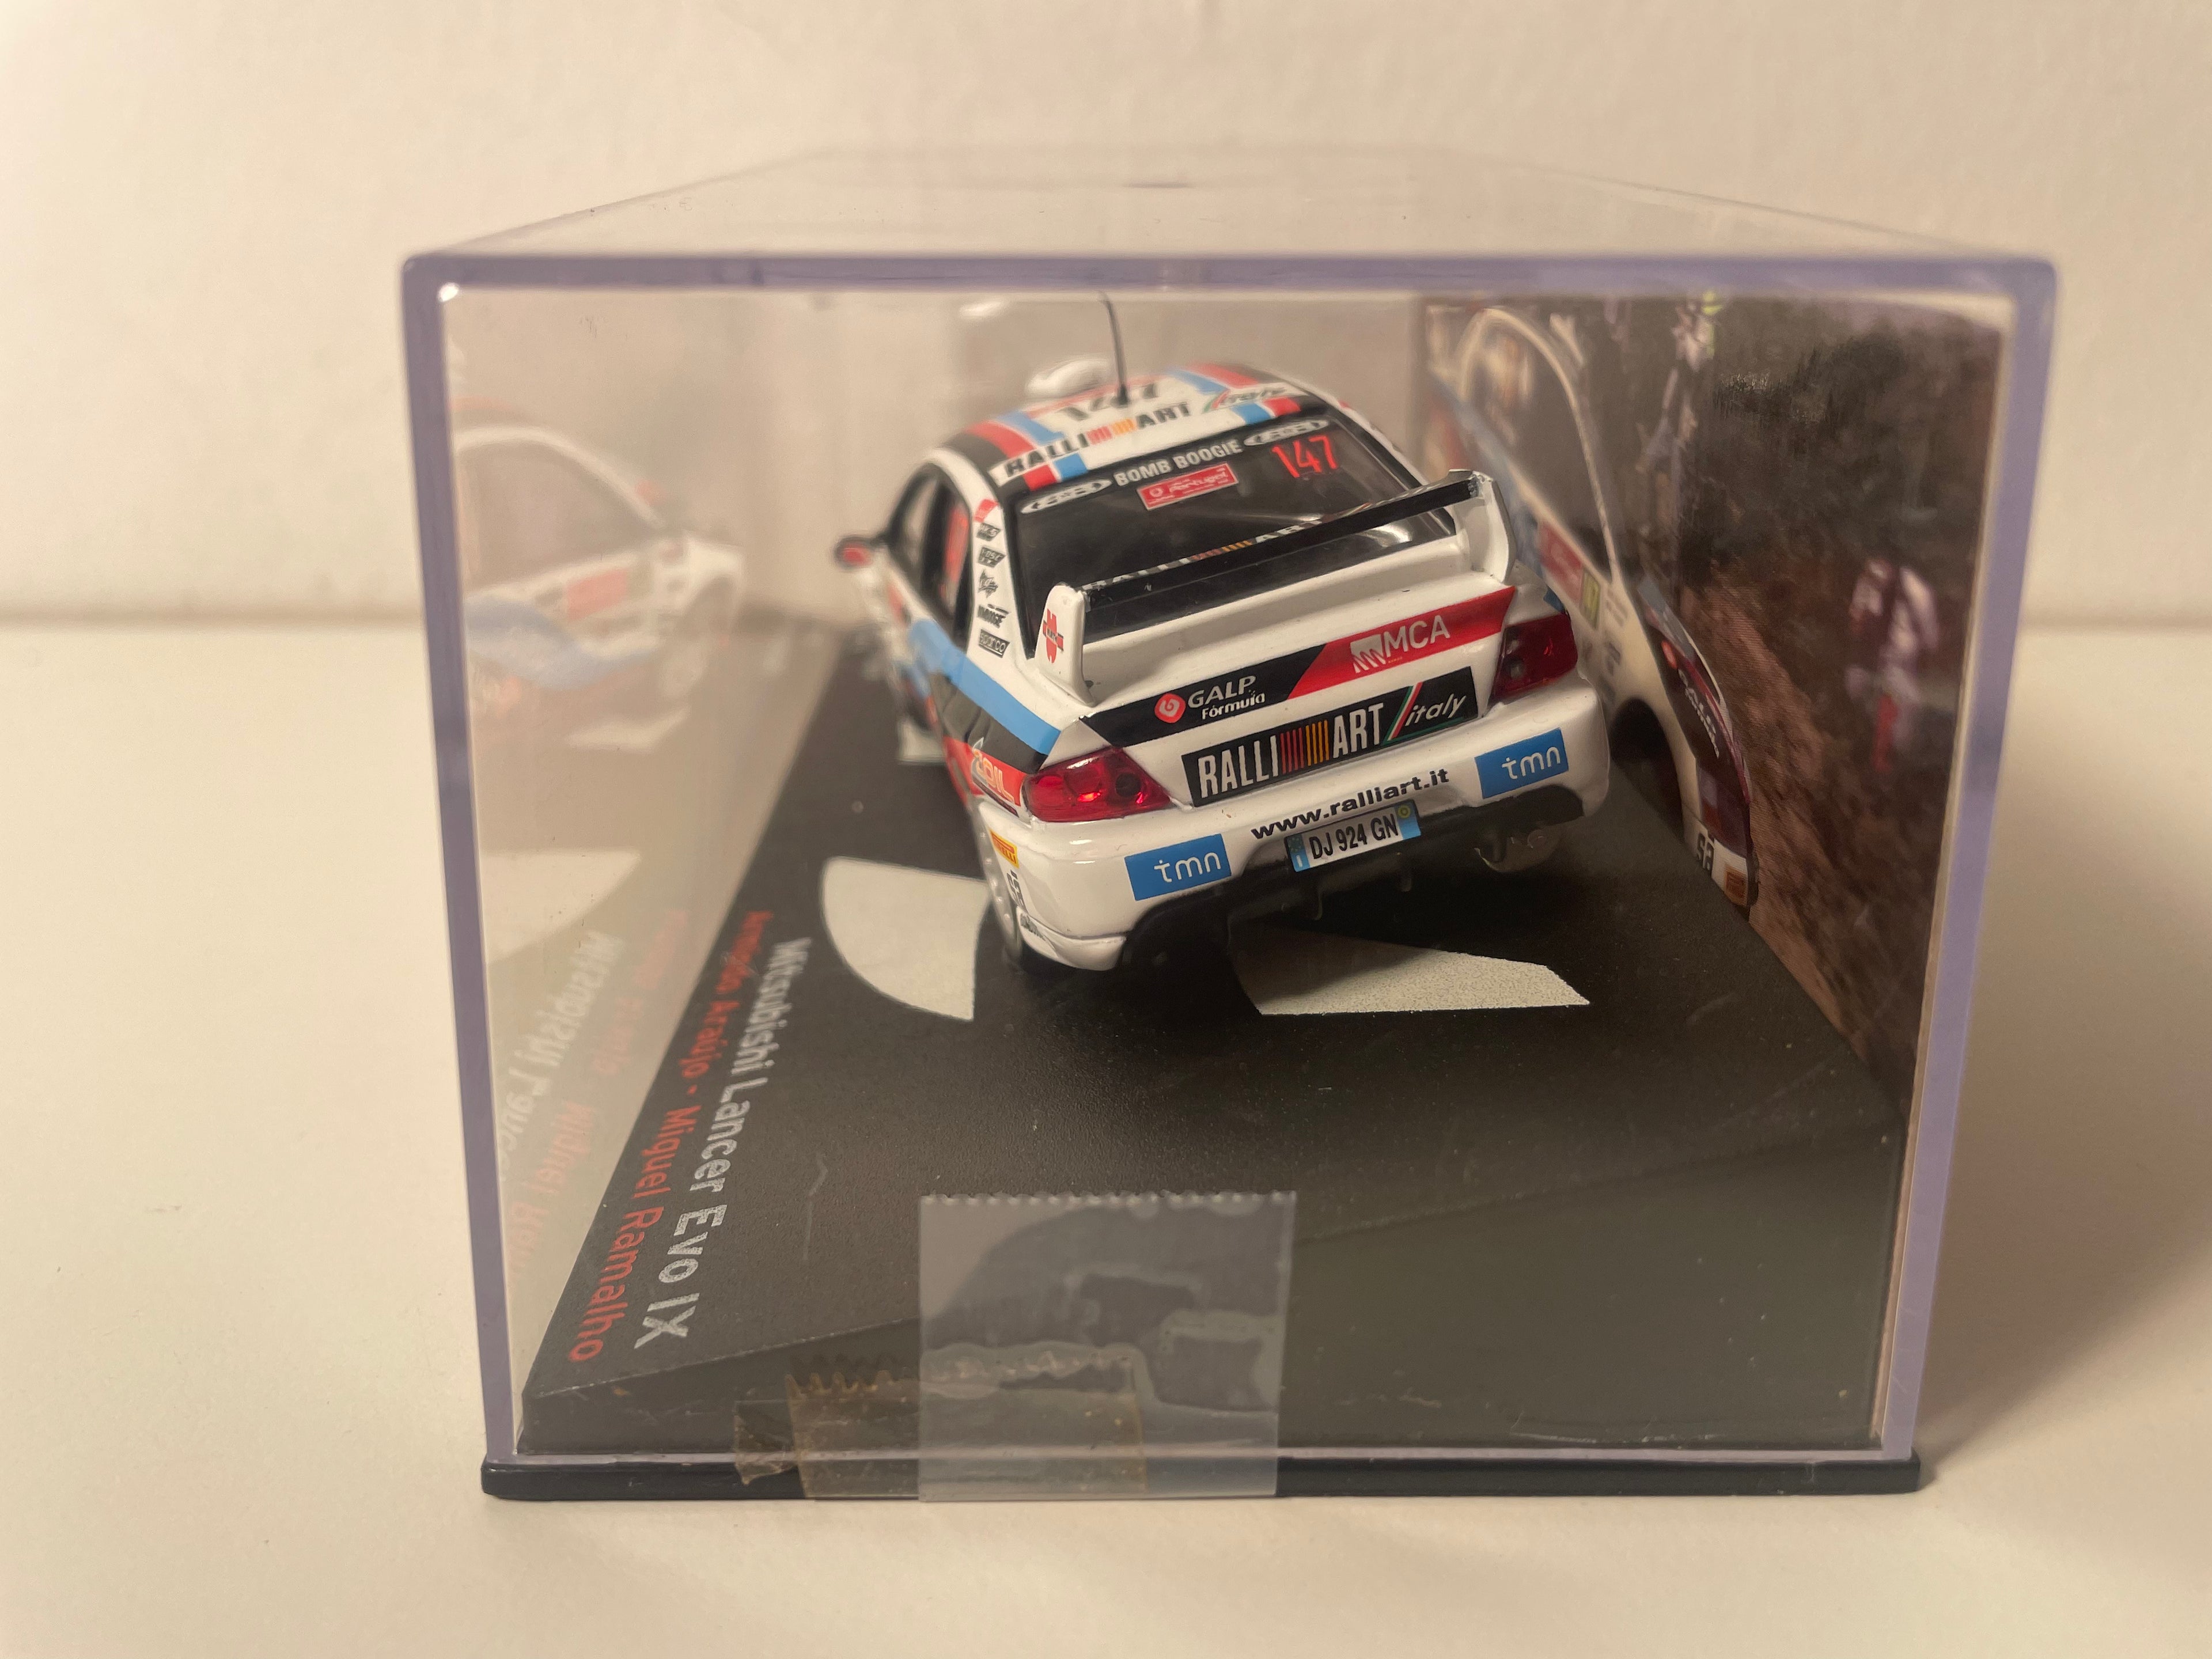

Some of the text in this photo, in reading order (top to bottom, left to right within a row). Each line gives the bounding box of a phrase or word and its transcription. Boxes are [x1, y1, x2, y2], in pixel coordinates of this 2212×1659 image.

[1004, 433, 1089, 478] RALLI
[1135, 403, 1191, 430] ART
[1113, 439, 1243, 487] BOMB BOOGIE
[1271, 435, 1338, 478] 147
[1383, 615, 1450, 658] MCA
[1187, 675, 1256, 709] GALP
[1198, 693, 1467, 799] RALLI ART italy
[1501, 746, 1561, 780] tmn
[1250, 768, 1450, 840] www.ralliart.it
[1308, 835, 1334, 859] DJ
[1336, 823, 1368, 852] 924
[1370, 813, 1399, 841] GN
[1153, 852, 1221, 882] tmn
[633, 1105, 702, 1199] Miguel
[634, 936, 812, 1349] Mitsubishi Lancer Evo IX
[568, 1206, 665, 1363] Ramalho
